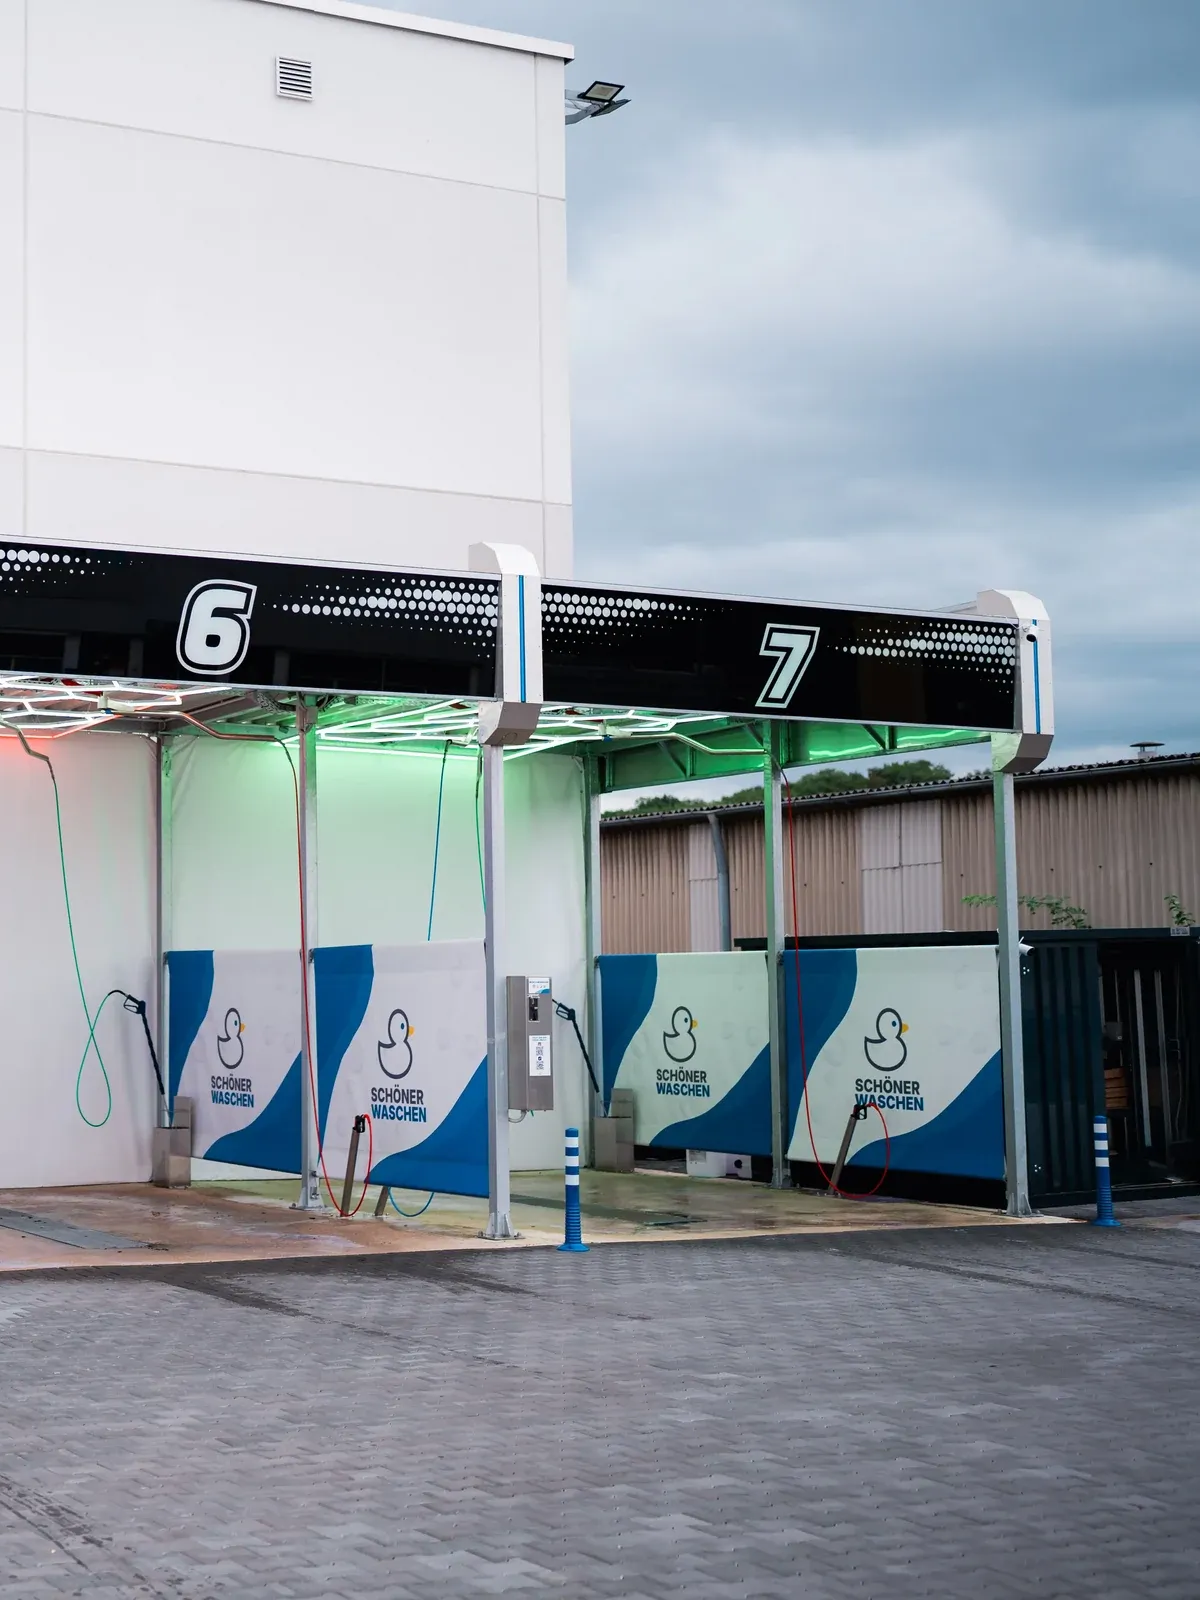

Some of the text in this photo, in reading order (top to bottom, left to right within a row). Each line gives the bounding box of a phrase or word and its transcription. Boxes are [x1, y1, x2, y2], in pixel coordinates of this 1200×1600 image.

[176, 579, 257, 675] 6
[755, 623, 820, 708] 7
[211, 1073, 252, 1092] SCHÖNER
[656, 1066, 707, 1083] SCHÖNER
[371, 1084, 424, 1105] SCHÖNER
[656, 1082, 710, 1097] WASCHEN
[855, 1076, 920, 1095] SCHÖNER
[211, 1090, 254, 1108] WASCHEN
[855, 1094, 924, 1111] WASCHEN
[371, 1104, 426, 1122] WASCHEN
